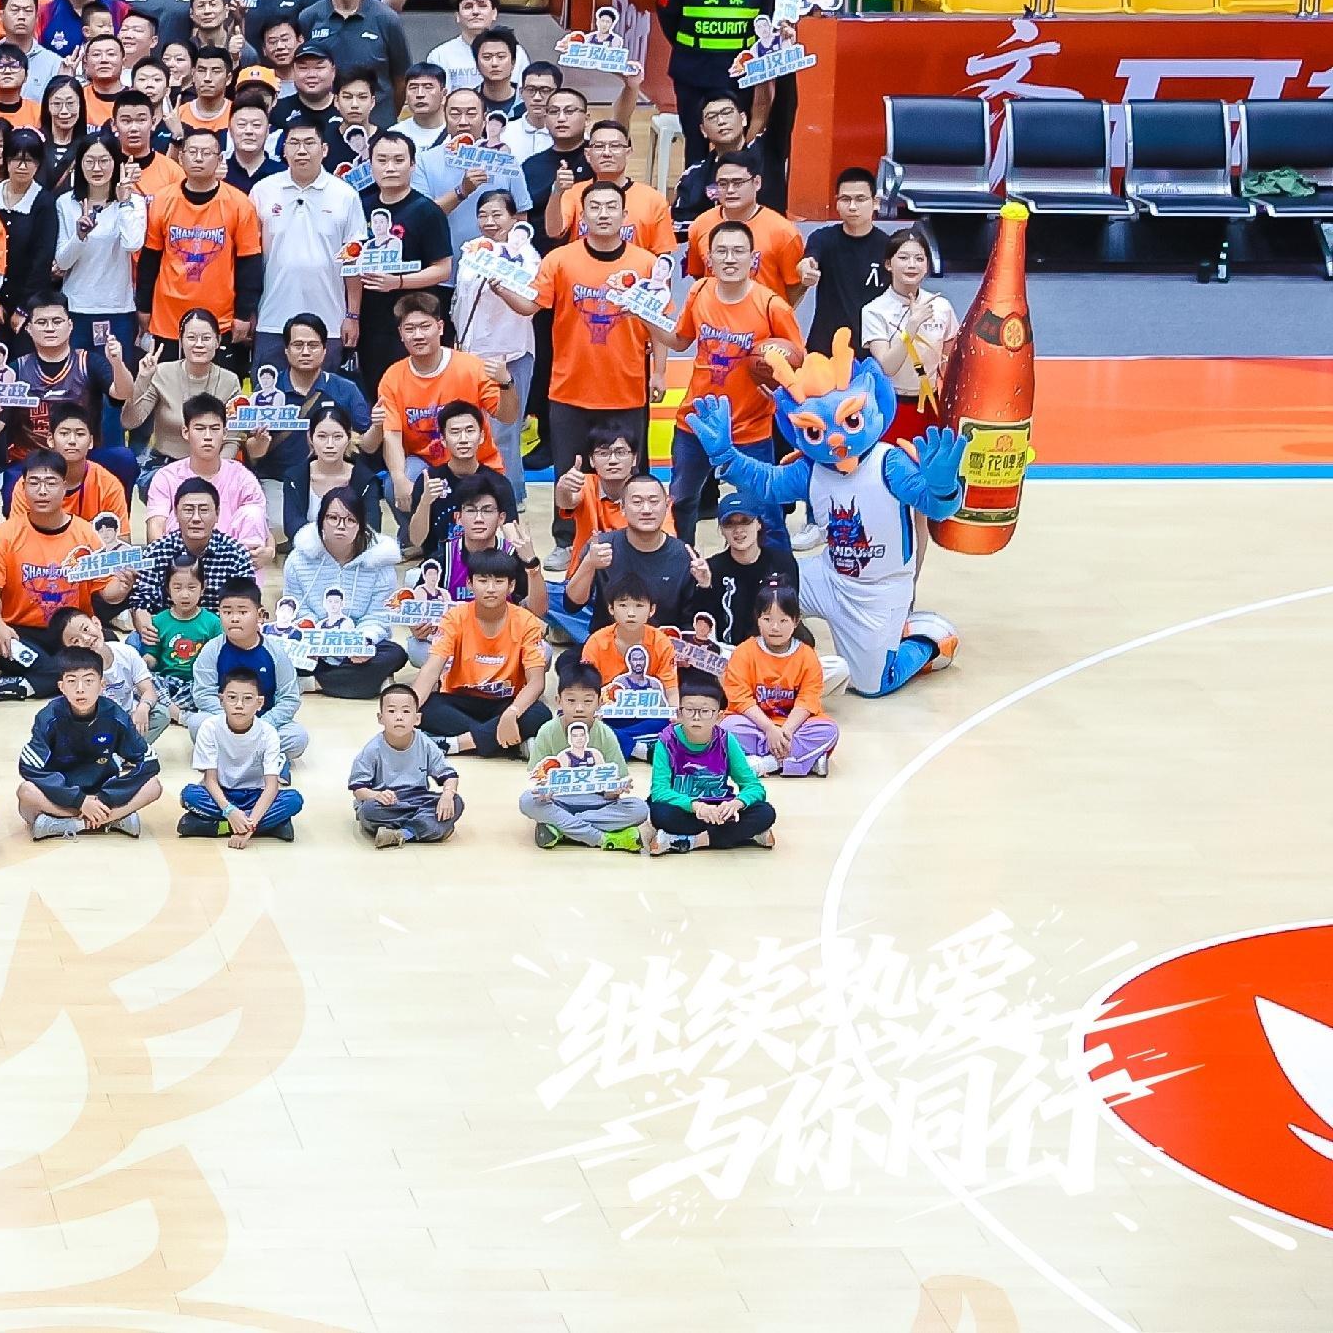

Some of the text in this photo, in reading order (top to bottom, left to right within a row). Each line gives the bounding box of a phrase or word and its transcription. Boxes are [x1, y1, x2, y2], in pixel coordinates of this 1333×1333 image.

[695, 20, 749, 36] SECURITY
[168, 225, 225, 244] SHANDONG
[550, 766, 618, 784] 杨文学
